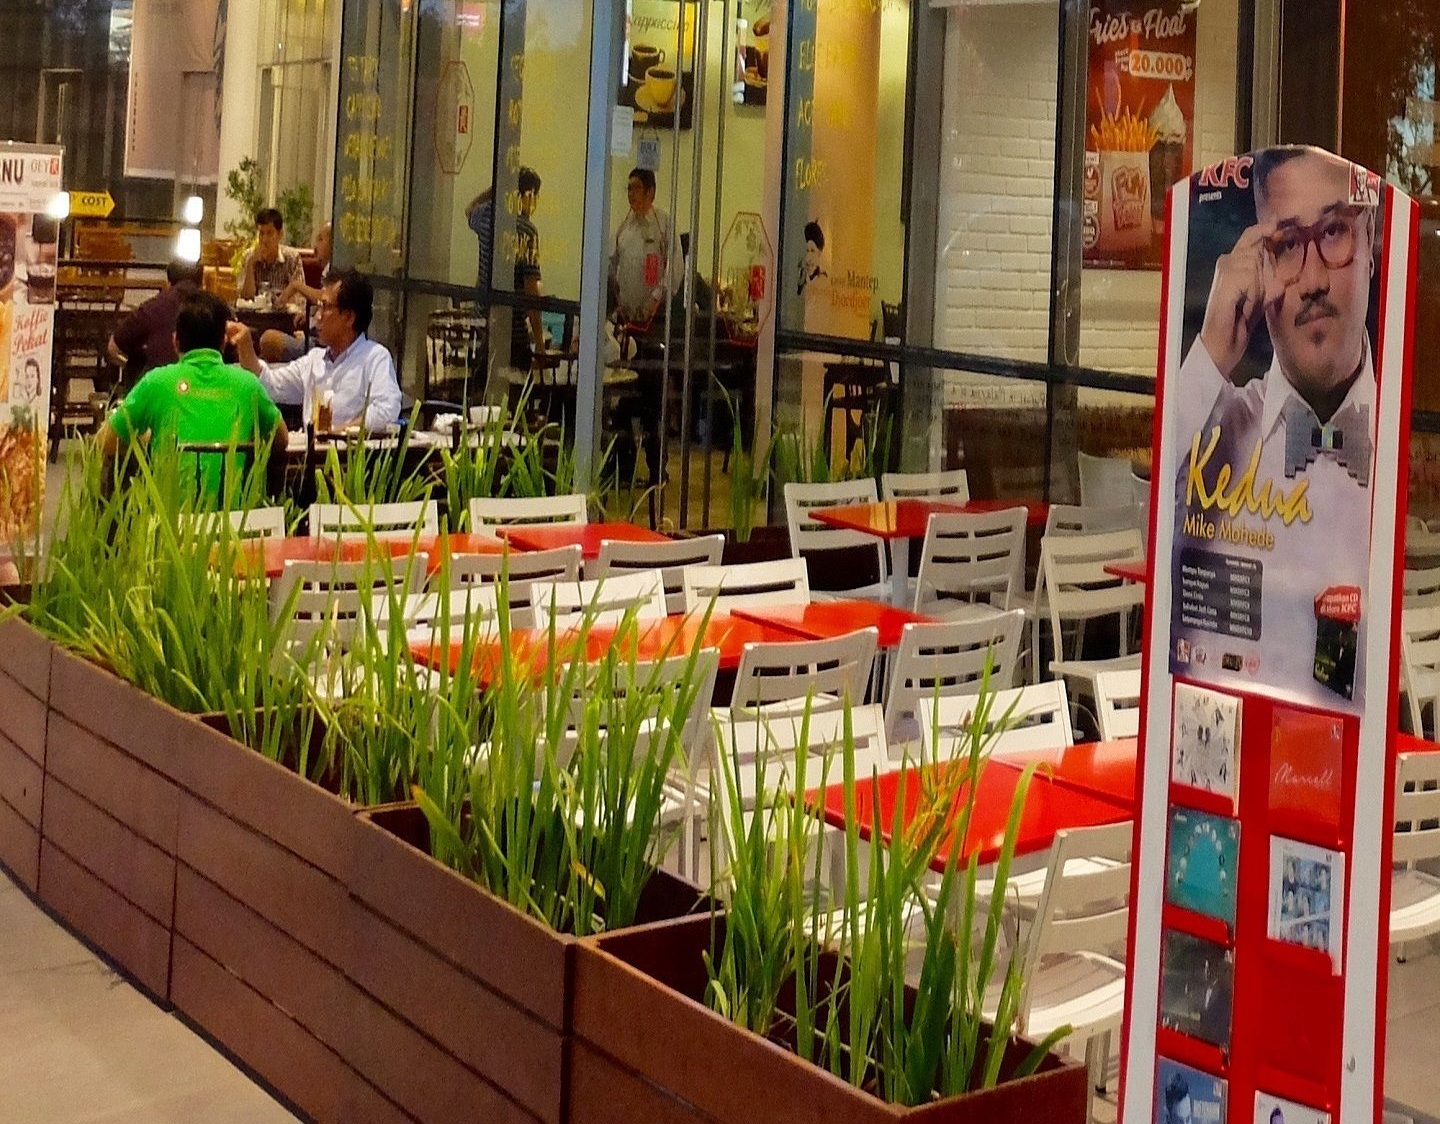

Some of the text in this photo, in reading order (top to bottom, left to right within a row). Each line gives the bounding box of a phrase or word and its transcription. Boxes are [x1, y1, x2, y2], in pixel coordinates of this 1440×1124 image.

[1144, 8, 1187, 40] Float
[1131, 52, 1183, 76] 20.000
[2, 159, 24, 186] NU
[1199, 156, 1254, 189] KFC
[1186, 425, 1313, 526] Kedua
[1183, 513, 1275, 550] Mike Mohede
